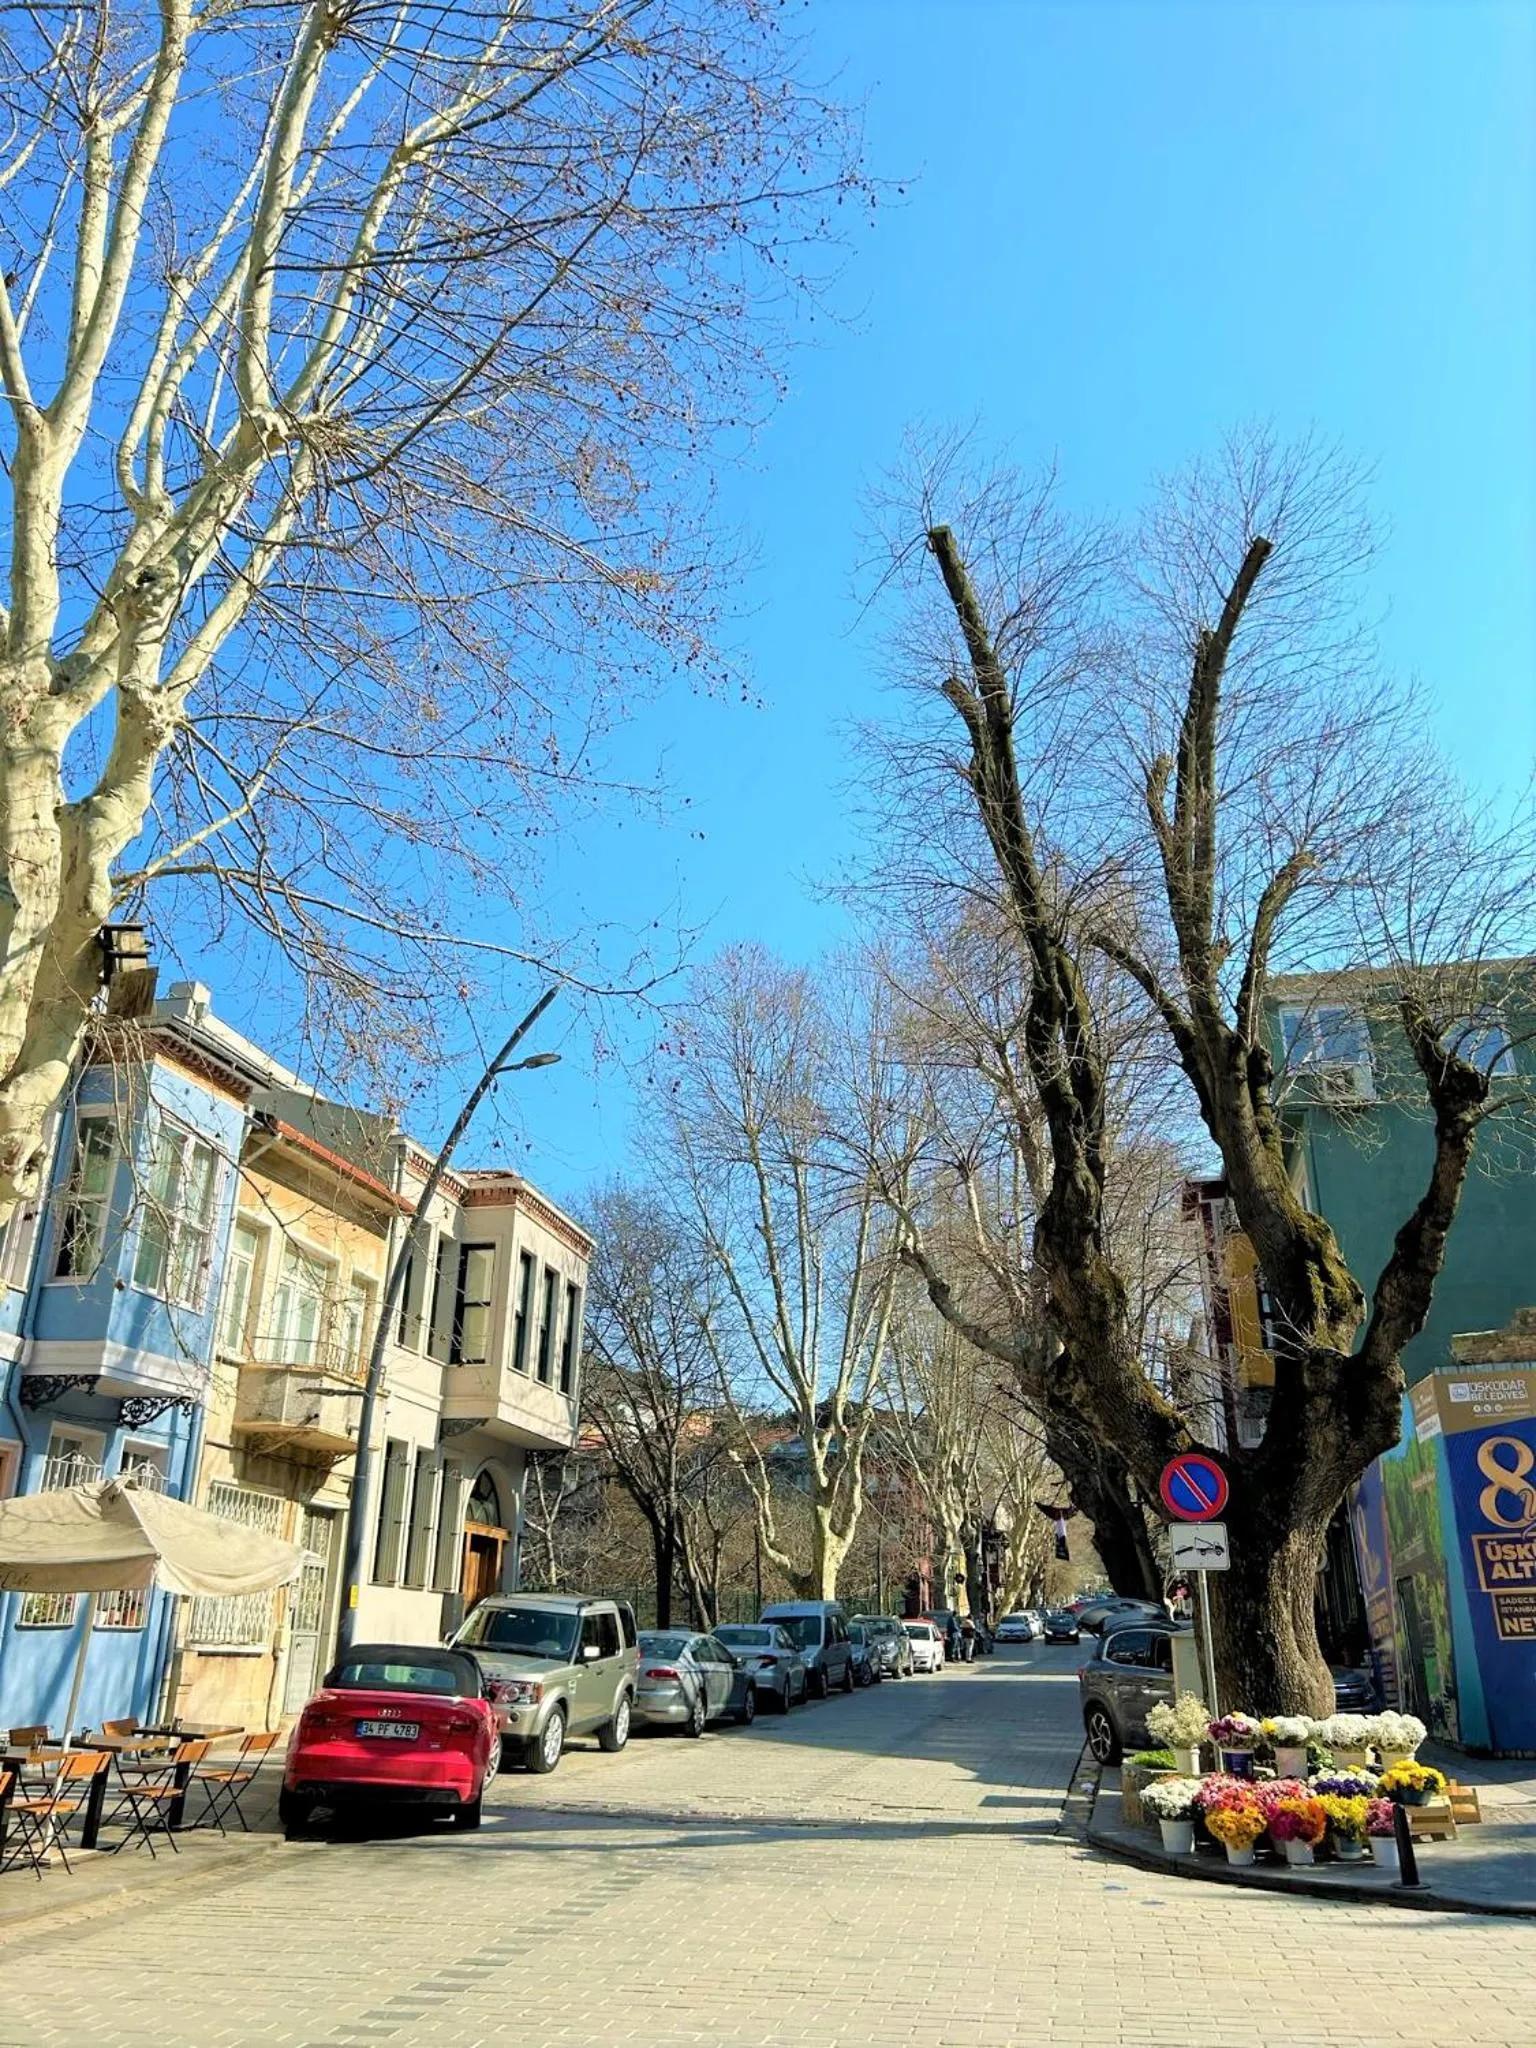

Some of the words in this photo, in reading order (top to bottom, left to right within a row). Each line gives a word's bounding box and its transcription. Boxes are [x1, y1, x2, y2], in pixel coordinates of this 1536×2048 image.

[1477, 1436, 1536, 1528] 8
[1491, 1560, 1536, 1580] ALT
[362, 1722, 373, 1734] 34
[378, 1724, 390, 1735] PF
[394, 1724, 417, 1737] 4783
